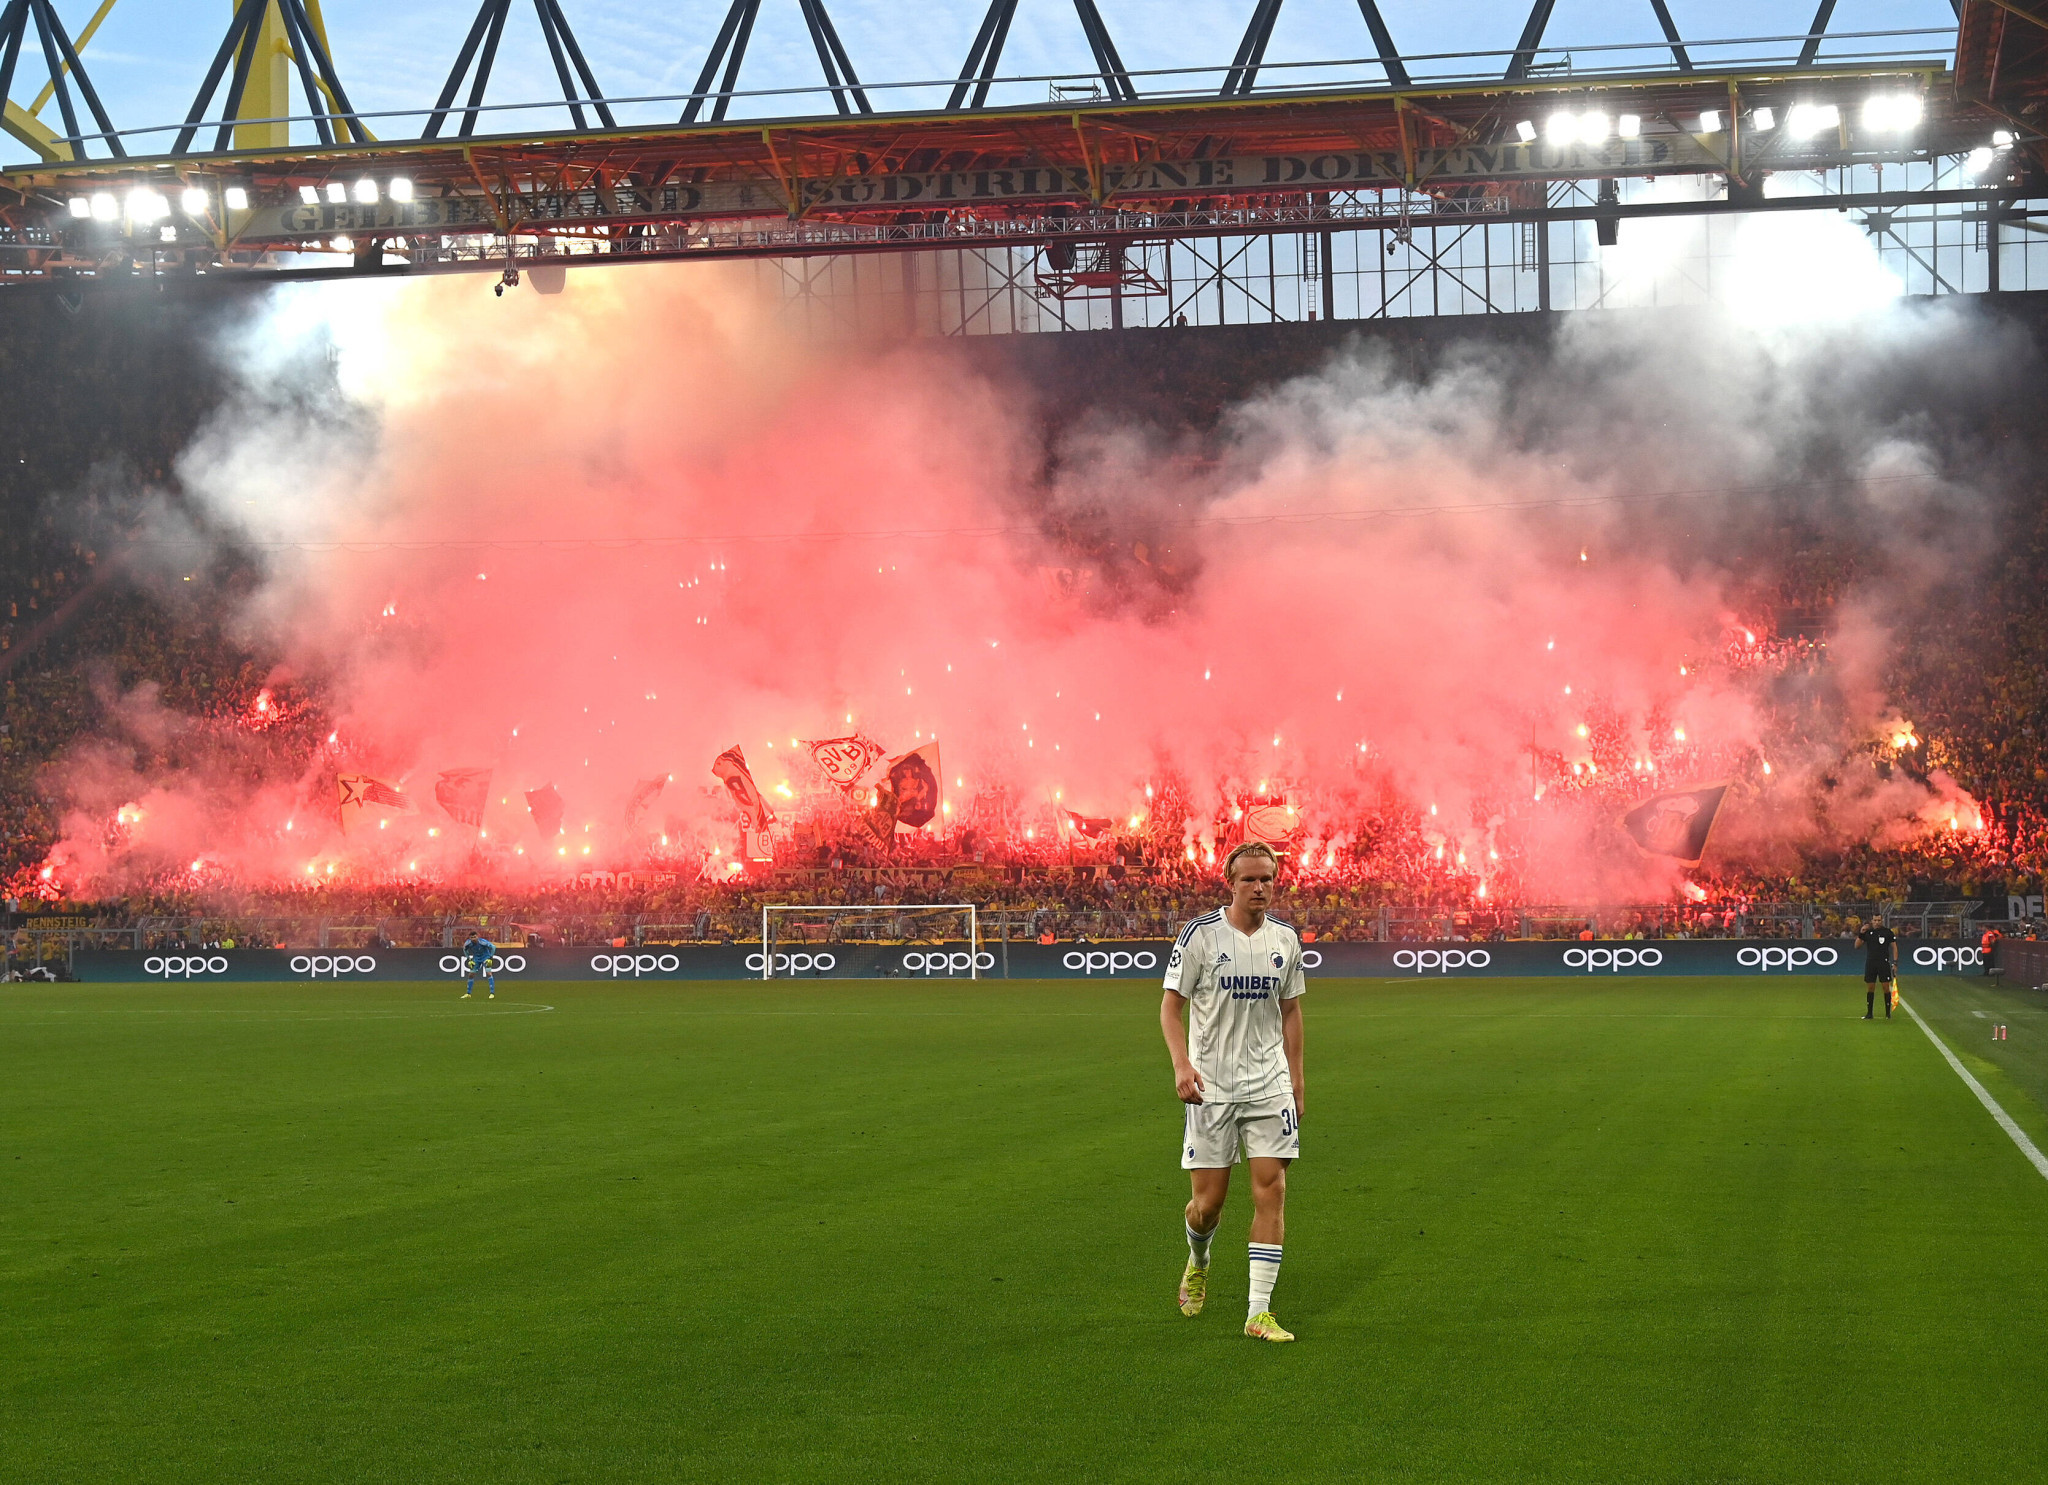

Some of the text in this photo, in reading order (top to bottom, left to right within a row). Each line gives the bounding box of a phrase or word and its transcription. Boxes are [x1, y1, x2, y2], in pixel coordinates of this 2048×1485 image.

[804, 158, 1234, 204] SÜDTRIBÜNE
[1262, 138, 1669, 183] DORTMUND
[820, 745, 861, 774] BVB
[26, 916, 87, 928] RENNSTEIG
[144, 956, 228, 978] oppo
[290, 955, 376, 977] oppo
[591, 954, 679, 977] oppo
[745, 953, 836, 976] oppo
[902, 952, 995, 976] oppo
[1063, 951, 1157, 974] oppo
[1393, 949, 1490, 973] oppo
[1563, 948, 1662, 972] oppo
[1737, 947, 1838, 971] oppo
[1221, 976, 1280, 990] UNIBET
